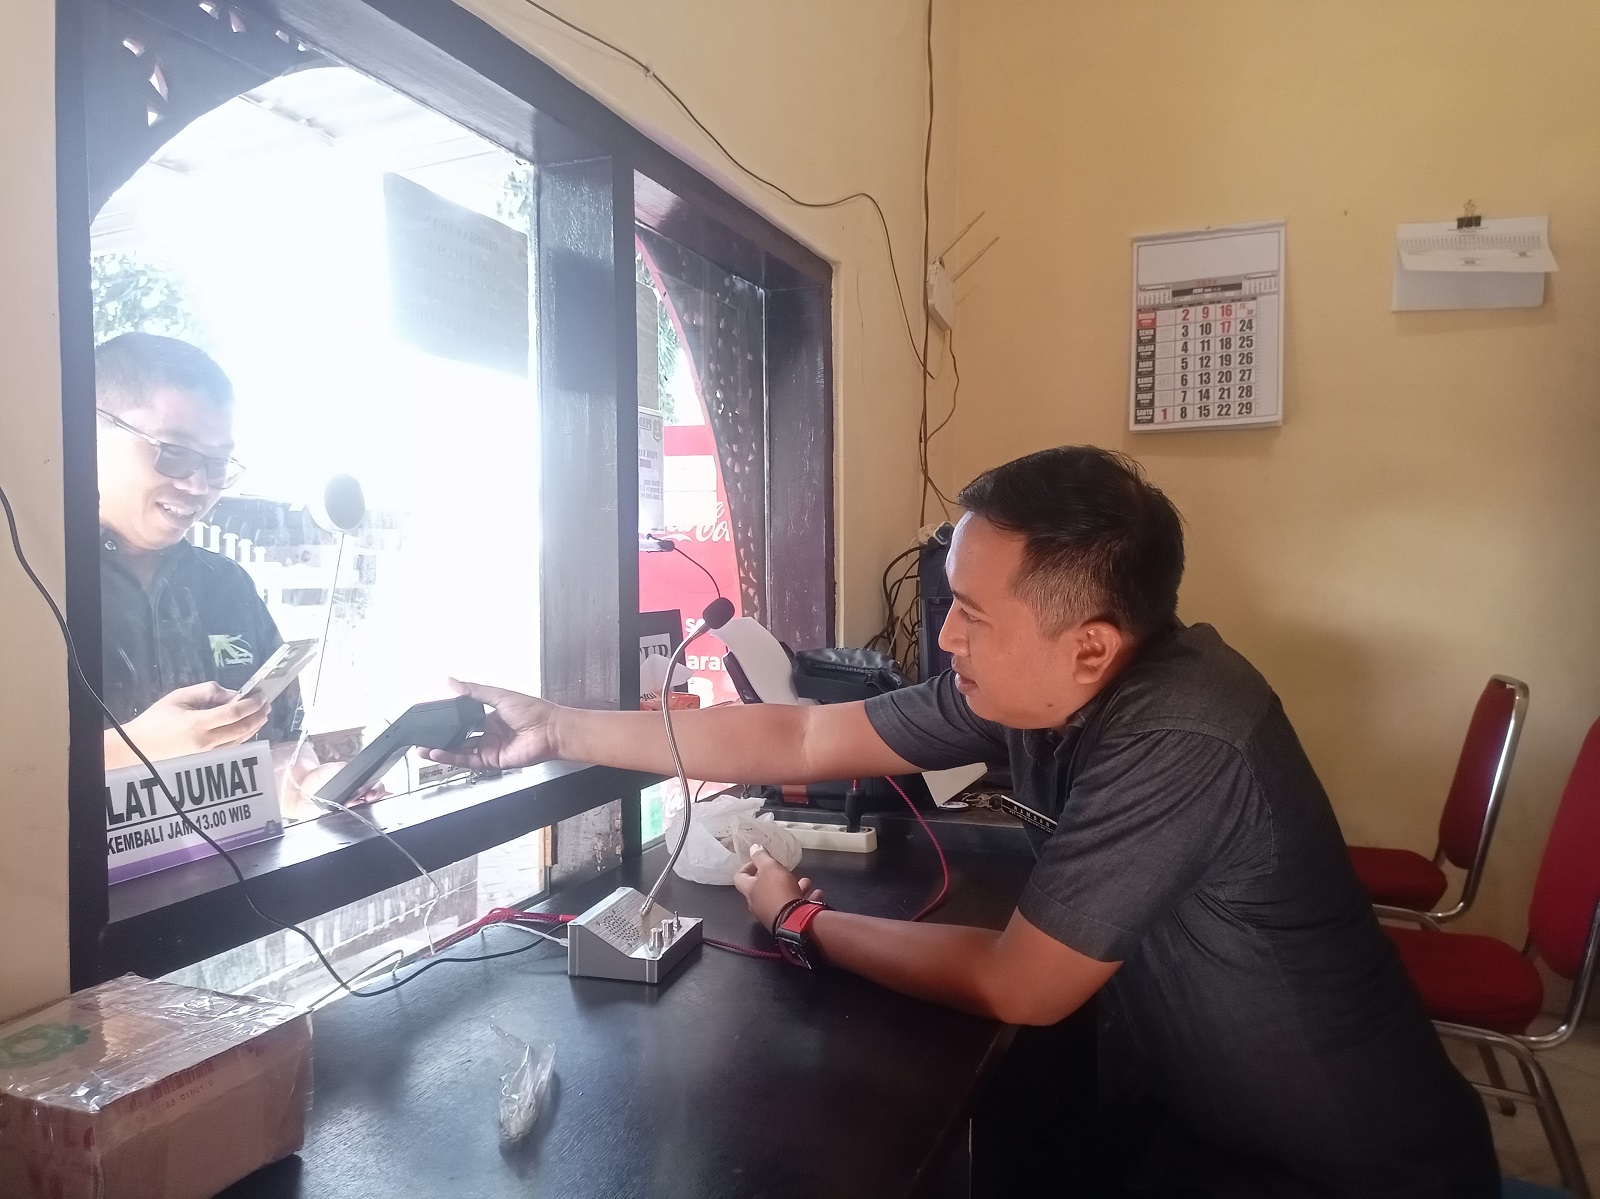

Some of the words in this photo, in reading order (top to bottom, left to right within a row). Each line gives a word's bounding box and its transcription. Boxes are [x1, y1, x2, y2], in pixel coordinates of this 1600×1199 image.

[1181, 309, 1189, 321] 2
[1202, 306, 1210, 319] 9
[1220, 304, 1233, 317] 16
[1181, 325, 1189, 338] 3
[1199, 322, 1212, 335] 10
[1220, 321, 1231, 334] 17
[1239, 319, 1253, 332] 24
[1181, 341, 1188, 353] 4
[1199, 339, 1211, 352] 11
[1219, 337, 1232, 350] 18
[1238, 335, 1253, 349] 25
[1181, 357, 1188, 370] 5
[1198, 355, 1211, 368] 12
[1219, 353, 1232, 367] 19
[1238, 352, 1253, 365] 26
[1181, 374, 1188, 386] 6
[1198, 372, 1211, 385] 13
[1217, 370, 1232, 384] 20
[1239, 368, 1252, 382] 27
[1181, 390, 1187, 403] 7
[1198, 388, 1210, 401] 14
[1218, 387, 1231, 400] 21
[1238, 385, 1253, 398] 28
[1161, 408, 1167, 420] 1
[1180, 406, 1187, 419] 8
[1197, 405, 1210, 417] 15
[1217, 403, 1231, 417] 22
[1237, 402, 1252, 415] 29
[105, 777, 159, 826] LAT
[173, 756, 258, 809] JUMAT
[107, 826, 164, 855] KEMBALI
[167, 818, 194, 840] JAM
[195, 809, 227, 831] 13.00
[228, 804, 251, 823] WIB
